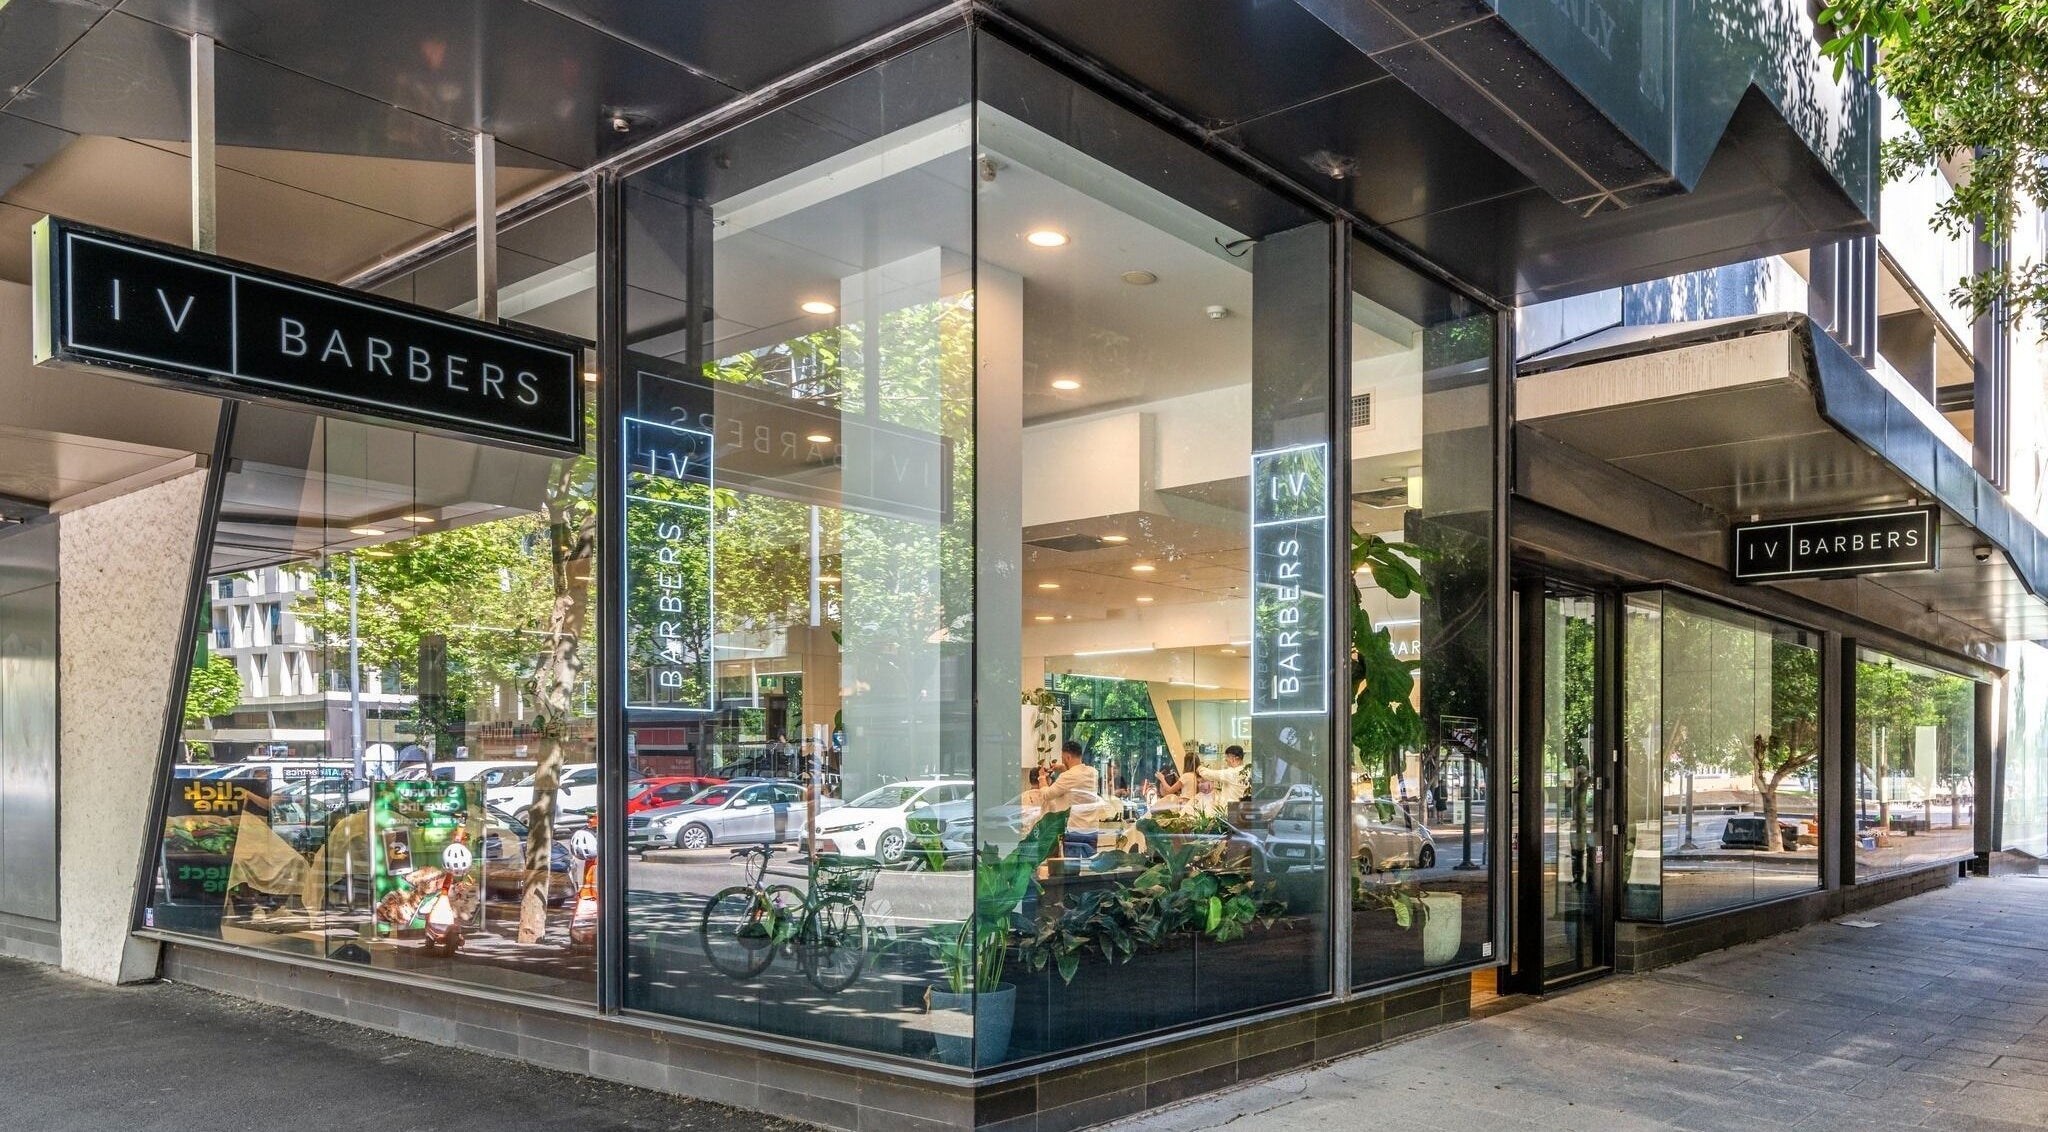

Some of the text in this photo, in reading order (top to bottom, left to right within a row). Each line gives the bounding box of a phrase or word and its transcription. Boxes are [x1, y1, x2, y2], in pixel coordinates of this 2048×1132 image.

[280, 317, 539, 406] BARBERS
[650, 449, 689, 480] IV
[1272, 471, 1306, 501] IV
[1799, 529, 1918, 556] BARBERS
[659, 521, 683, 687] BARBERS
[1279, 539, 1301, 695] BARBERS
